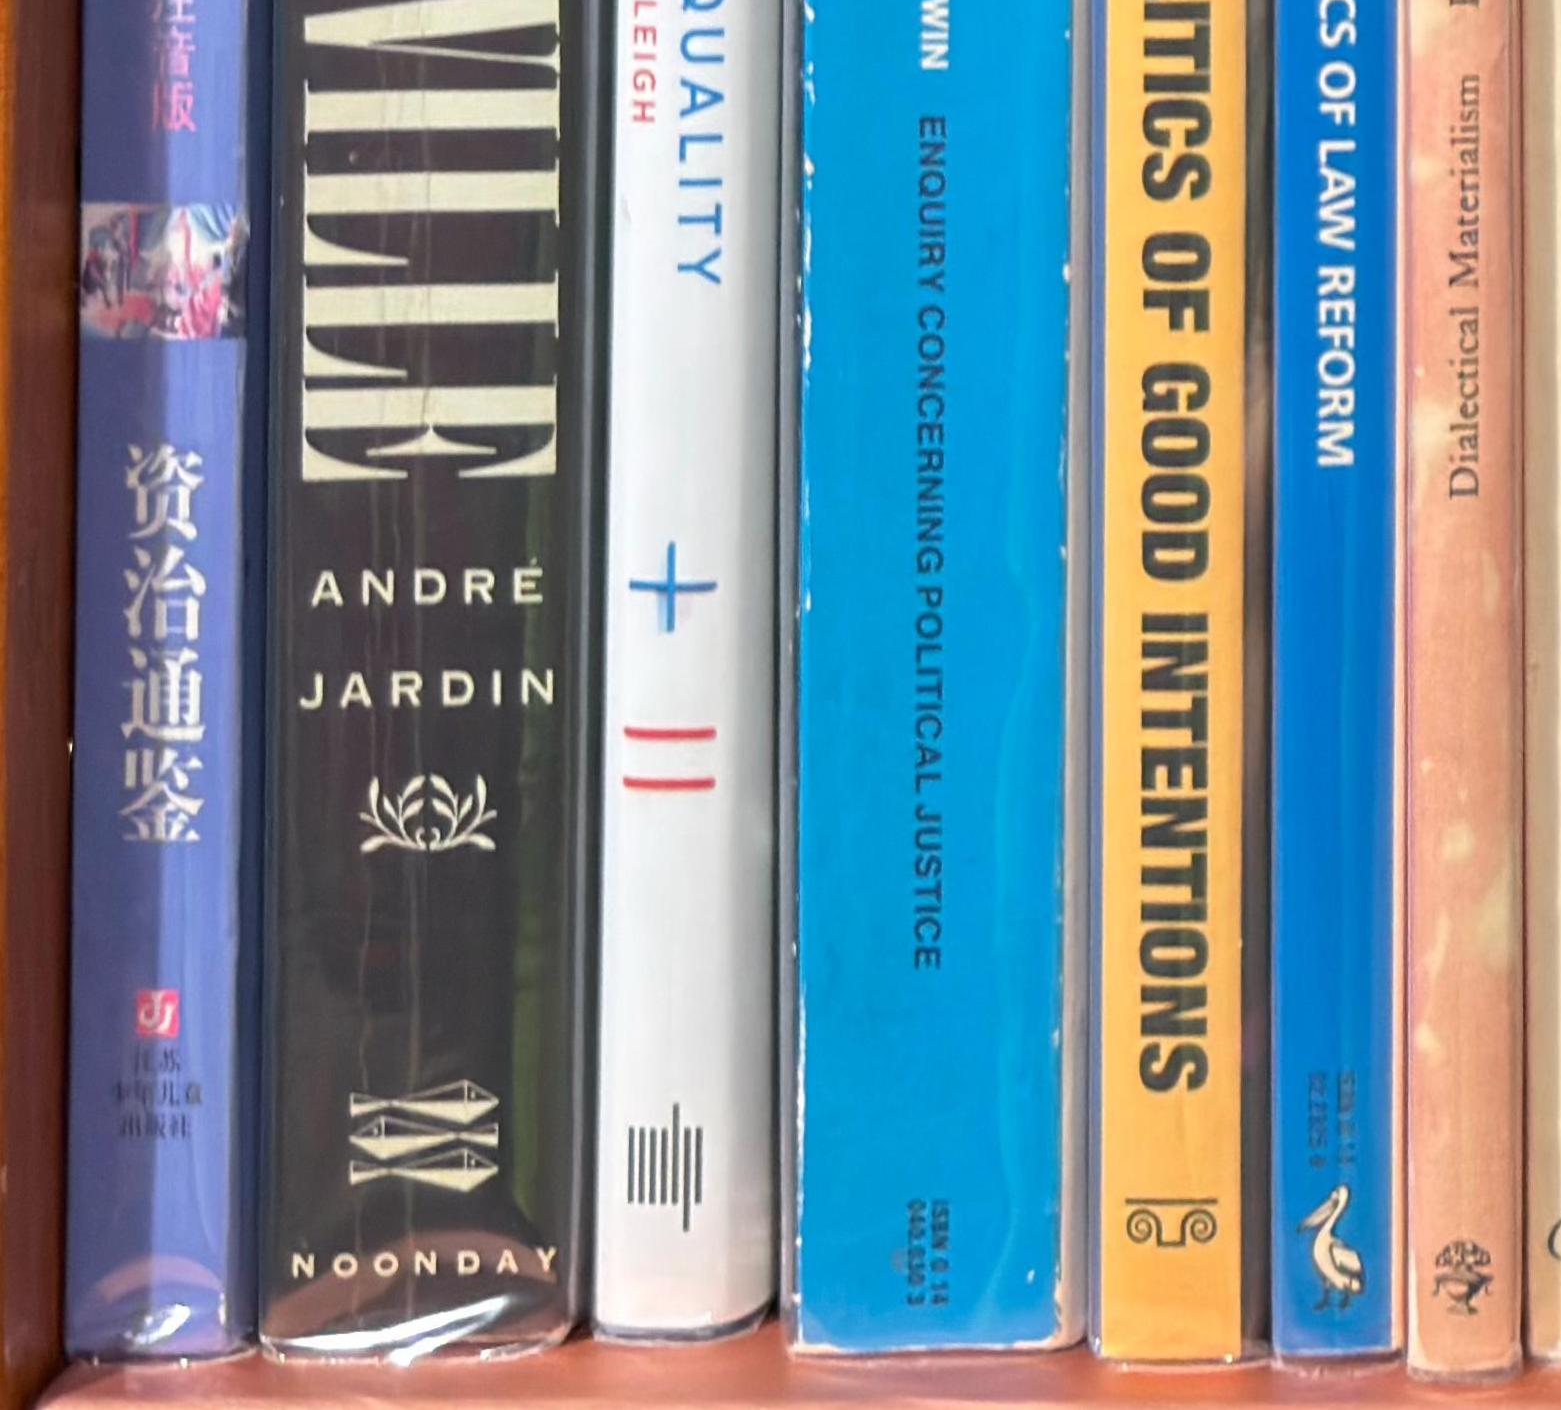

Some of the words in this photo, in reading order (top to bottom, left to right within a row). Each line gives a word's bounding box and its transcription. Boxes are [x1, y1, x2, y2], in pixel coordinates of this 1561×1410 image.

[918, 116, 946, 293] ENQUIRY
[1318, 140, 1355, 249] LAW
[1450, 73, 1481, 290] Materialism
[916, 304, 945, 576] CONCERNING
[1317, 267, 1355, 467] REFORM
[1449, 305, 1481, 499] Dialectical
[1141, 362, 1211, 580] GOOD
[119, 442, 207, 843] 资治通鉴
[311, 559, 545, 608] ANDRÉ
[300, 669, 556, 709] JARDIN
[915, 585, 944, 793] POLITICAL
[914, 803, 942, 969] JUSTICE
[1139, 614, 1209, 1093] INTENTIONS
[292, 1249, 558, 1277] NOONDAY
